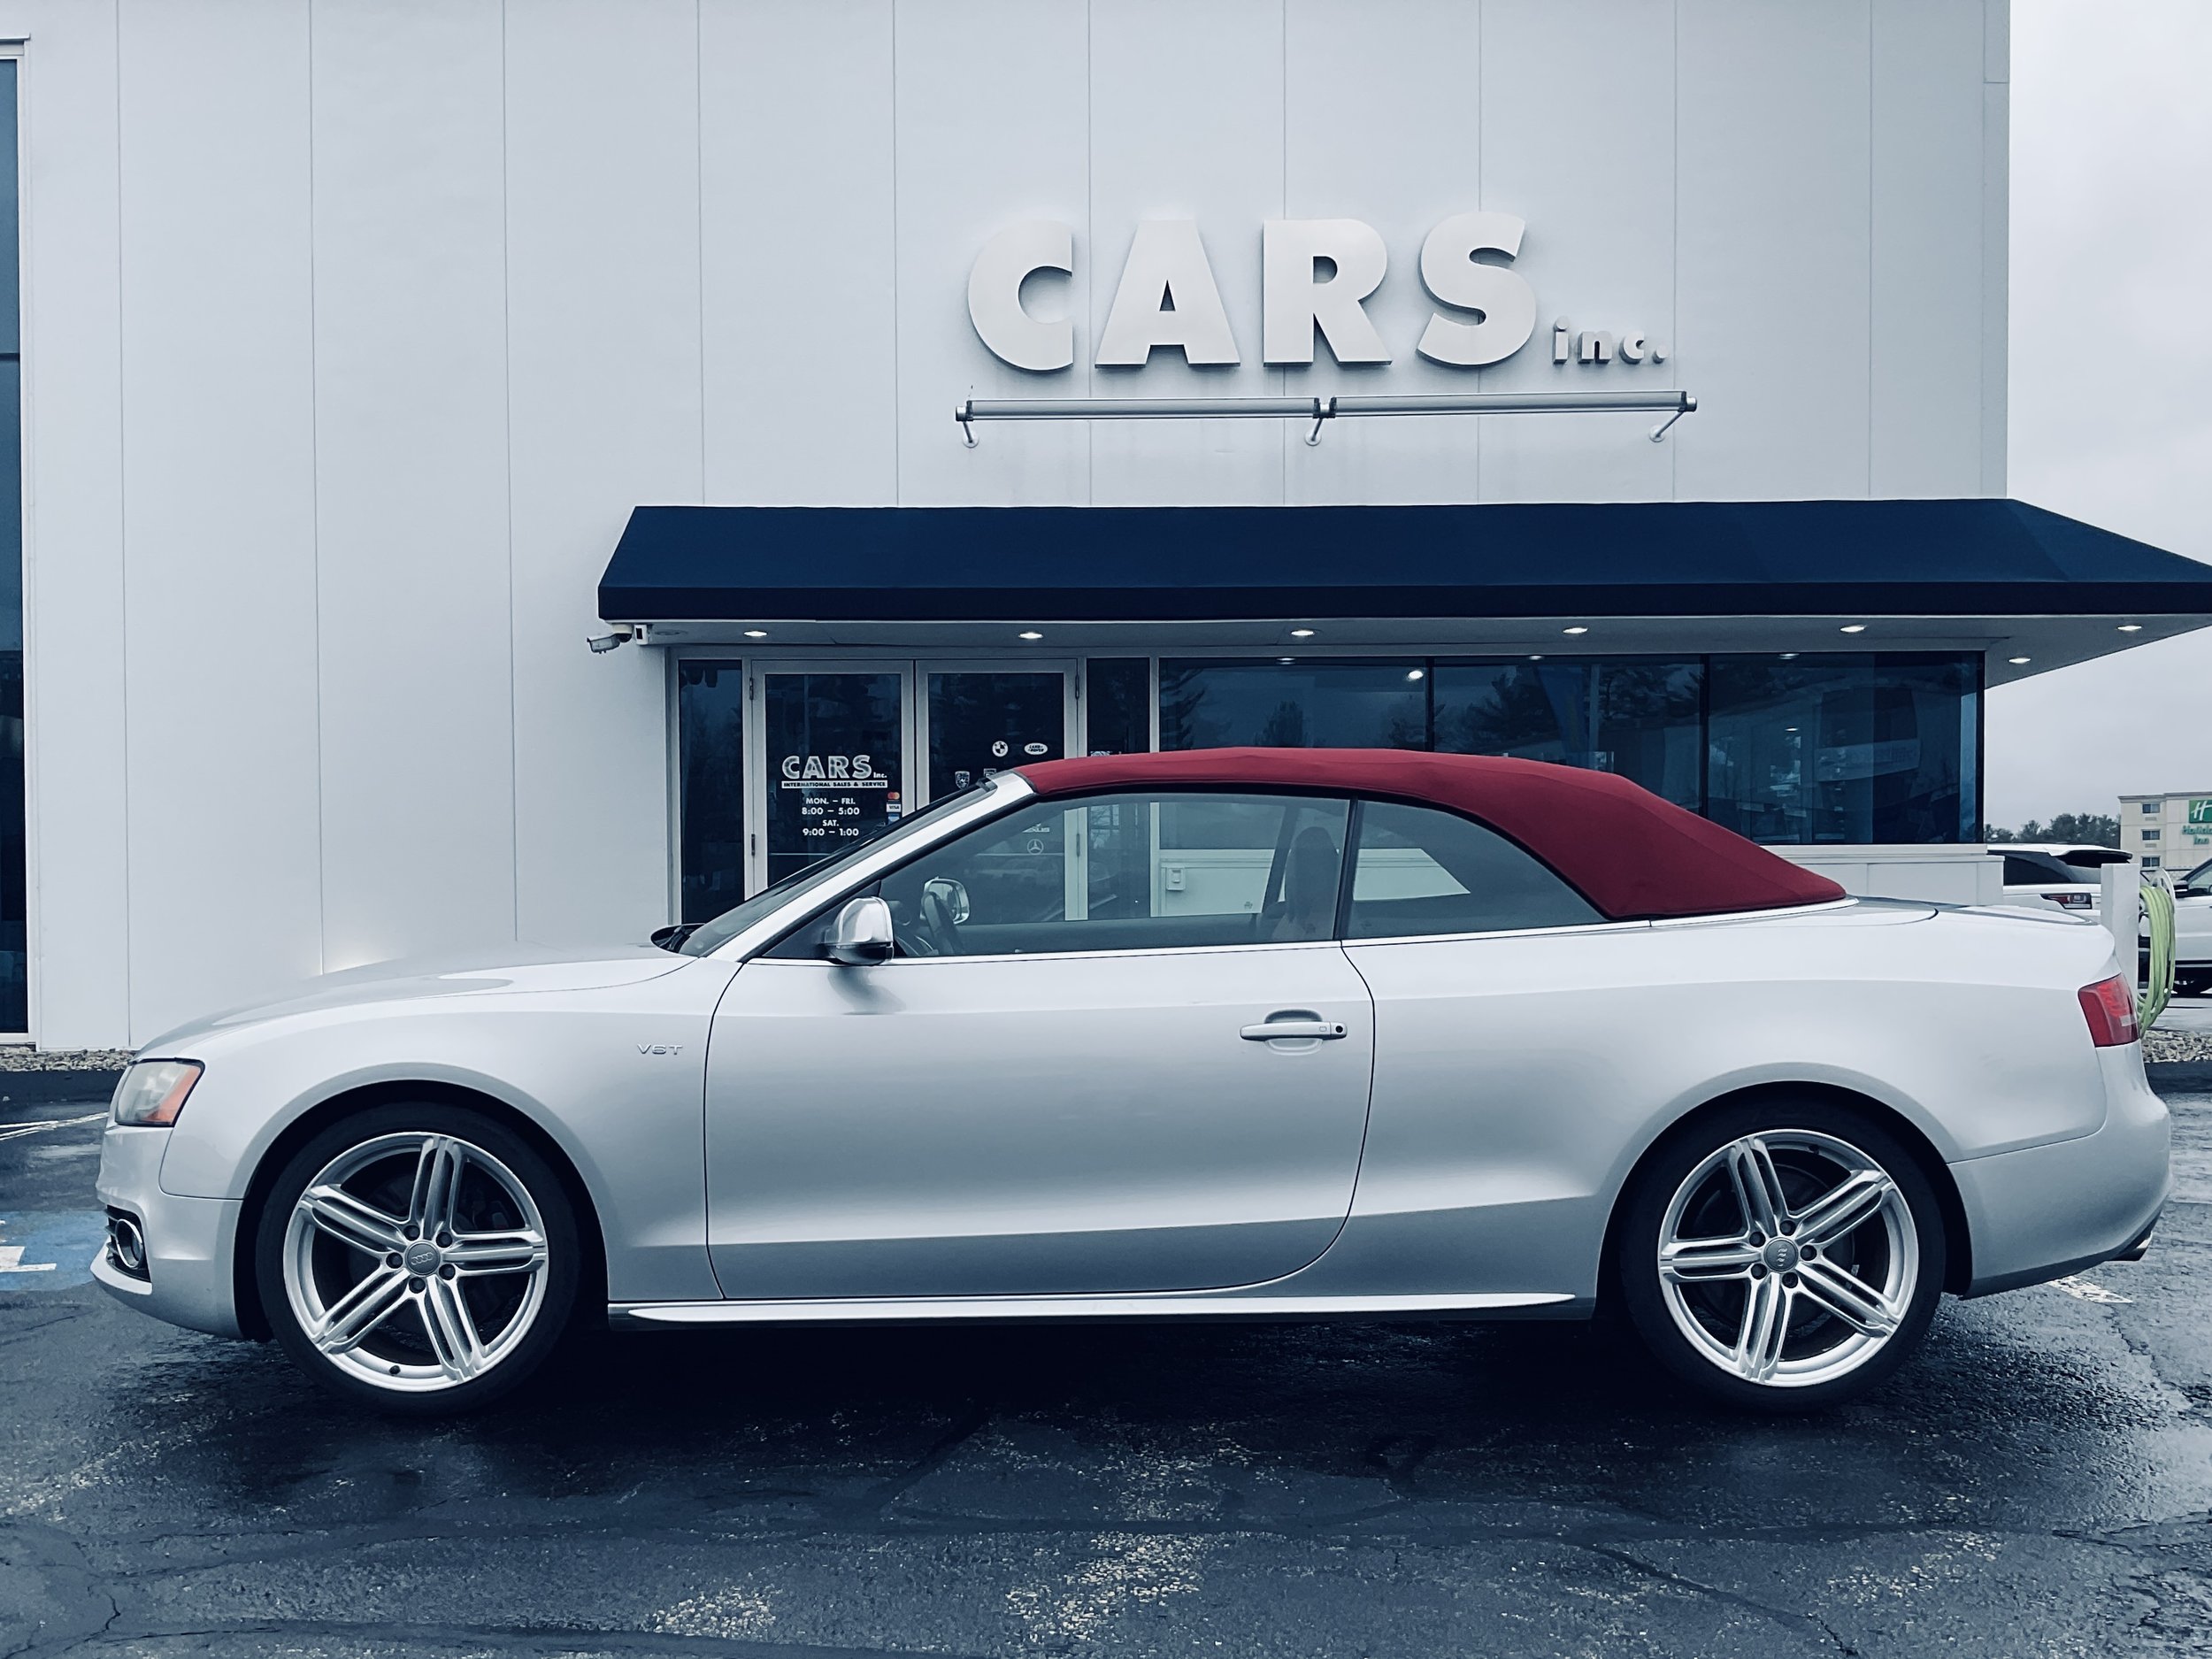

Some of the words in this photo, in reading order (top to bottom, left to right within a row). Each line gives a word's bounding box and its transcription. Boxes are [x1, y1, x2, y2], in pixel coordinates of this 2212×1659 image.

[967, 211, 1538, 372] CARS
[1552, 315, 1669, 365] inc.
[782, 755, 872, 779] CARS
[2194, 834, 2209, 845] Inn
[637, 1043, 683, 1056] V6T
